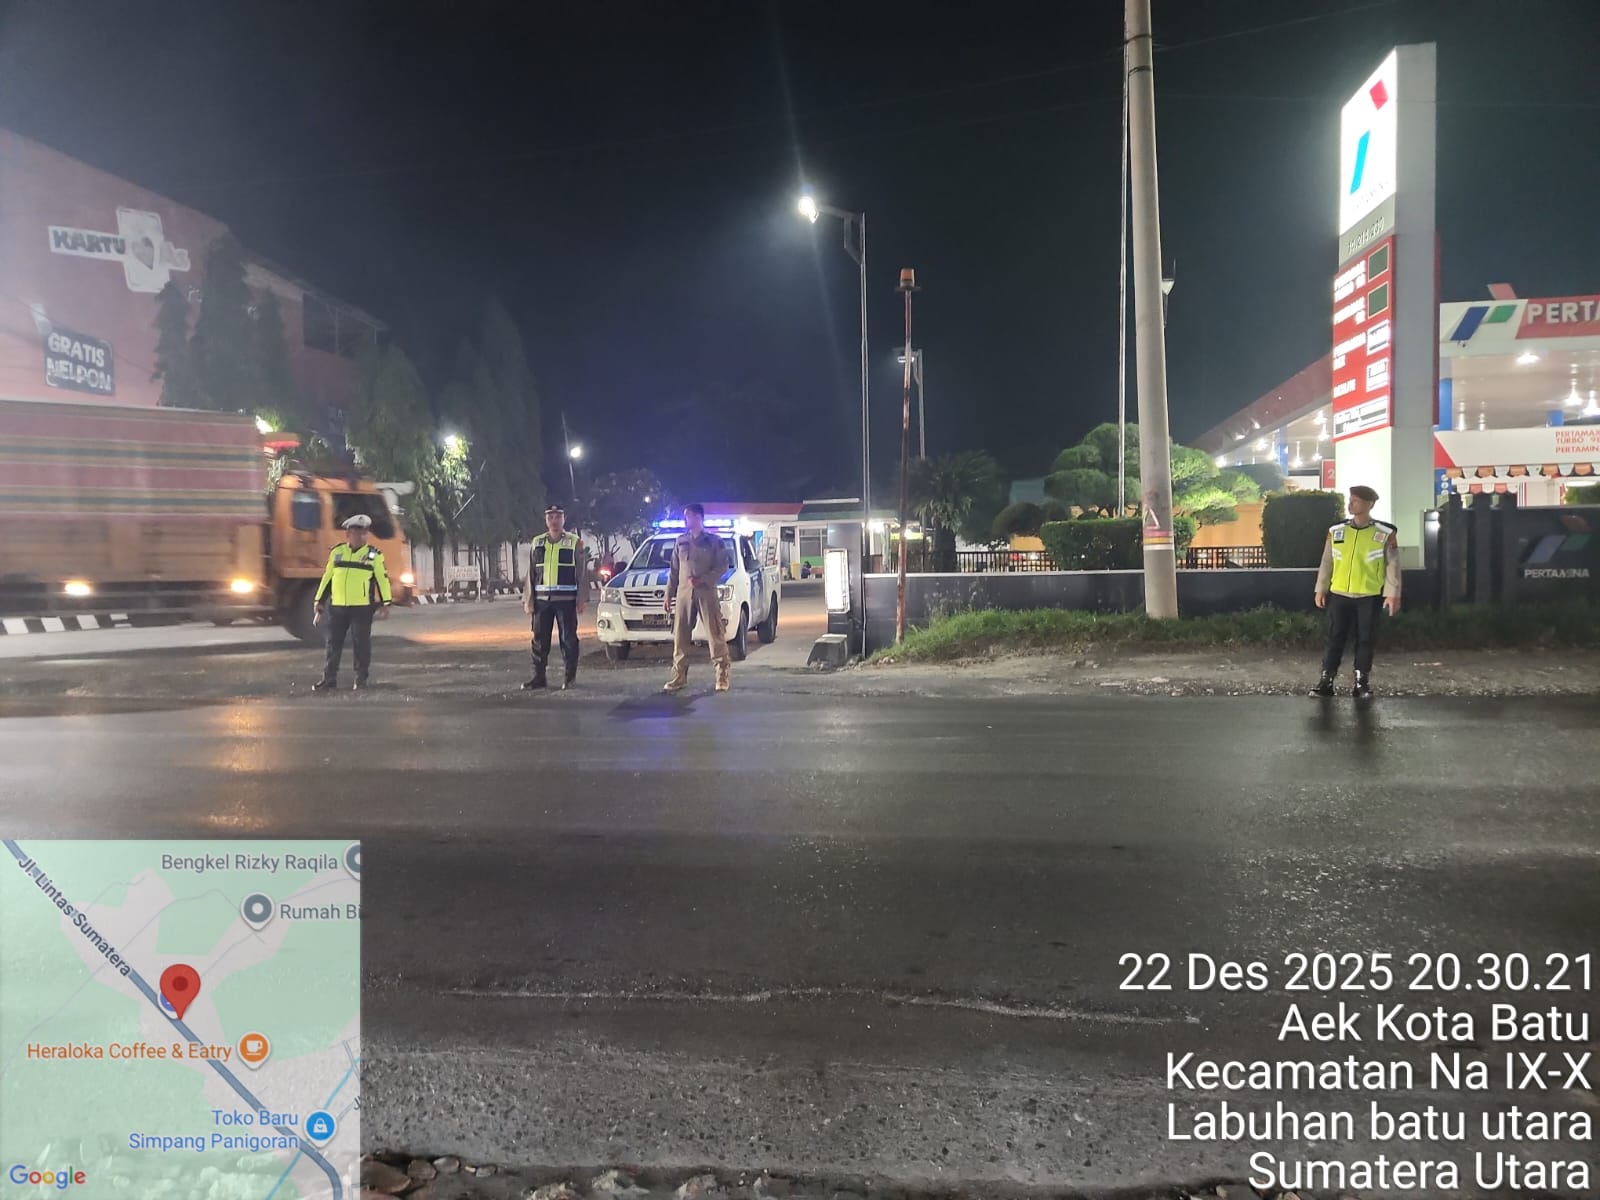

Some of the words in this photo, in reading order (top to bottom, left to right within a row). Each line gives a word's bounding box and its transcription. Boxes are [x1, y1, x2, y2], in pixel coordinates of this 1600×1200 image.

[53, 230, 126, 255] KARTU
[47, 332, 105, 368] GRATIS
[46, 356, 112, 391] NELPON
[1523, 568, 1590, 579] PERTAMINA
